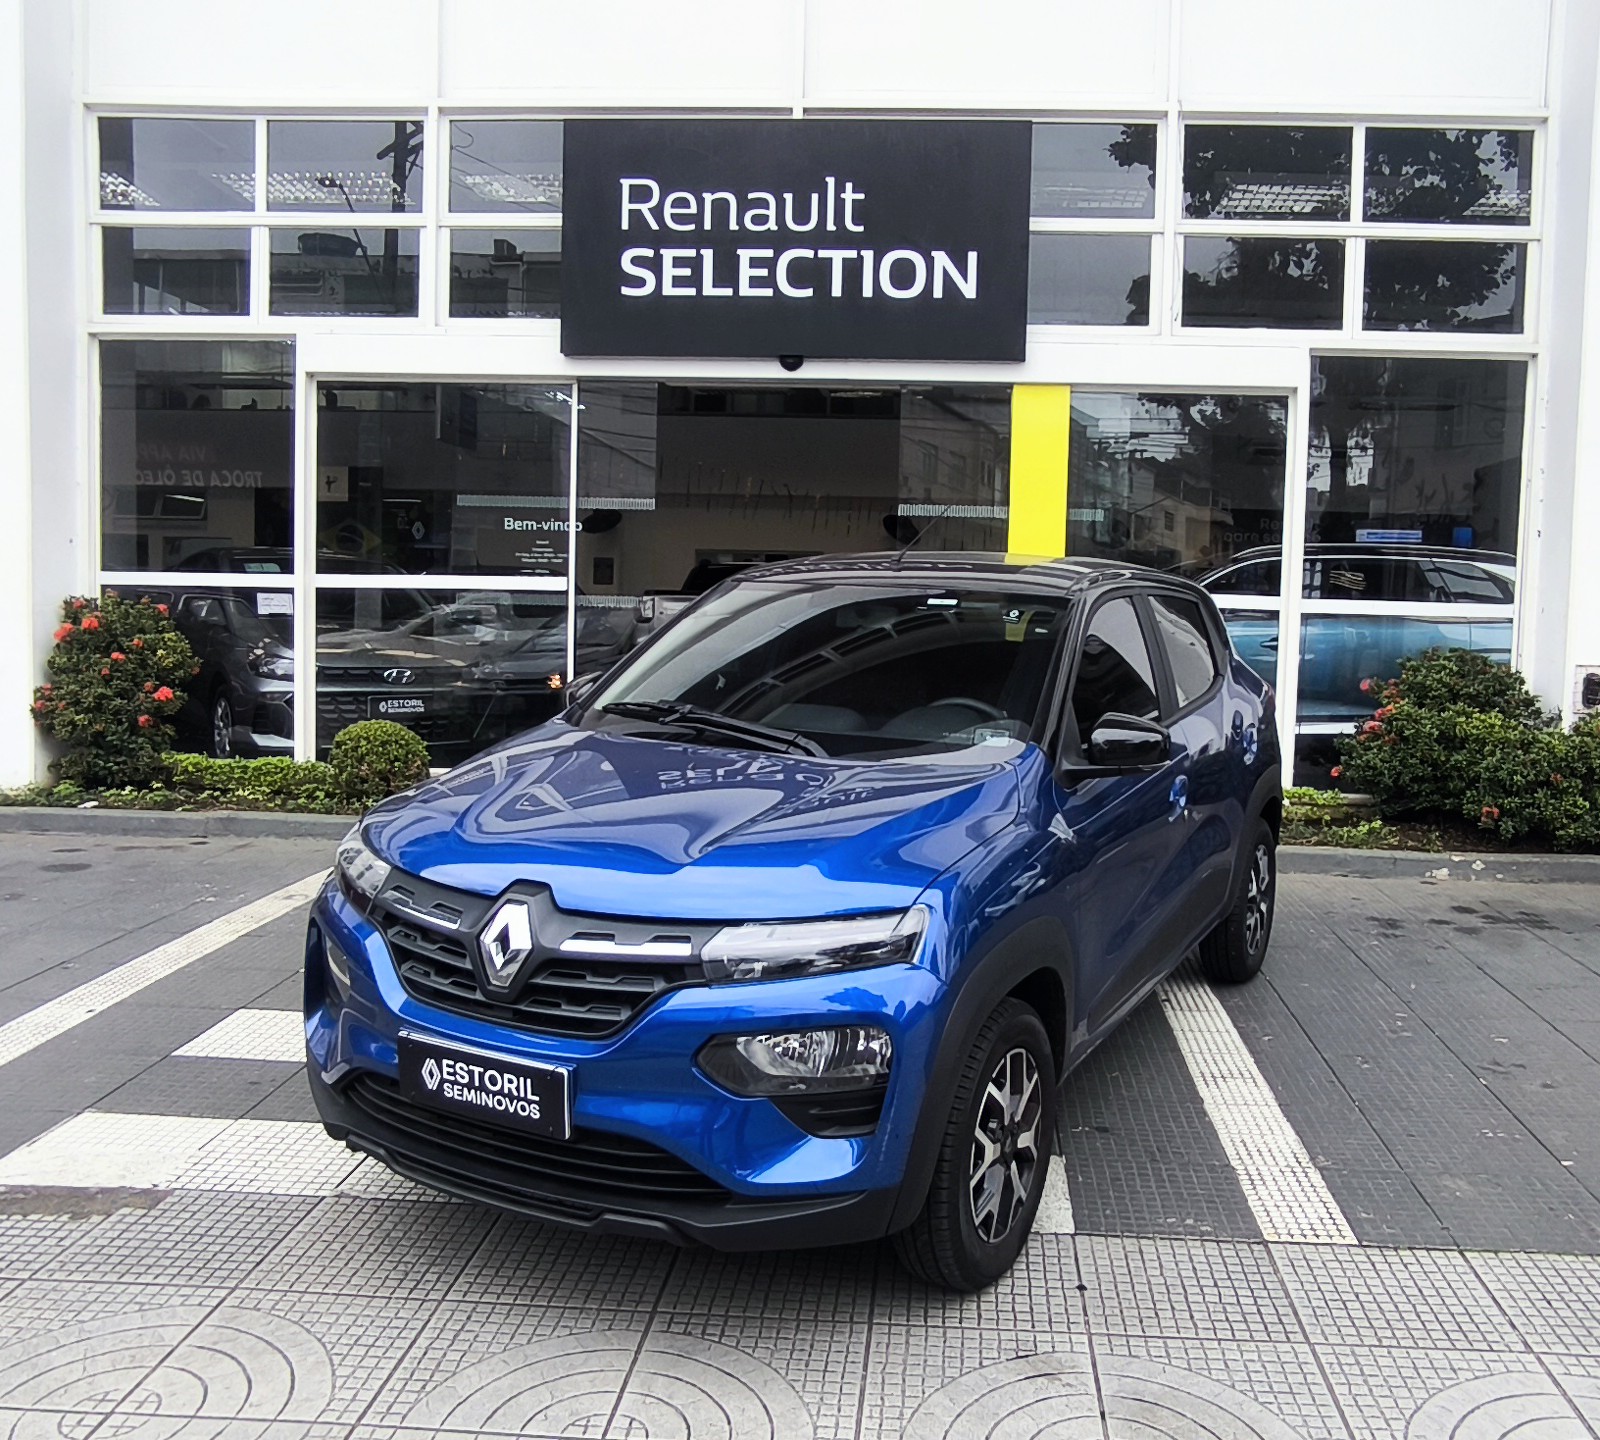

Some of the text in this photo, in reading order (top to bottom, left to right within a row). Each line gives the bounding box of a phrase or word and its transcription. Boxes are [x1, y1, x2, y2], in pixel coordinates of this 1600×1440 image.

[619, 176, 865, 232] Renault
[619, 247, 978, 299] SELECTION
[387, 699, 425, 708] ESTORIL
[442, 1059, 540, 1101] ESTORIL
[443, 1082, 541, 1119] SEMINOVOS
